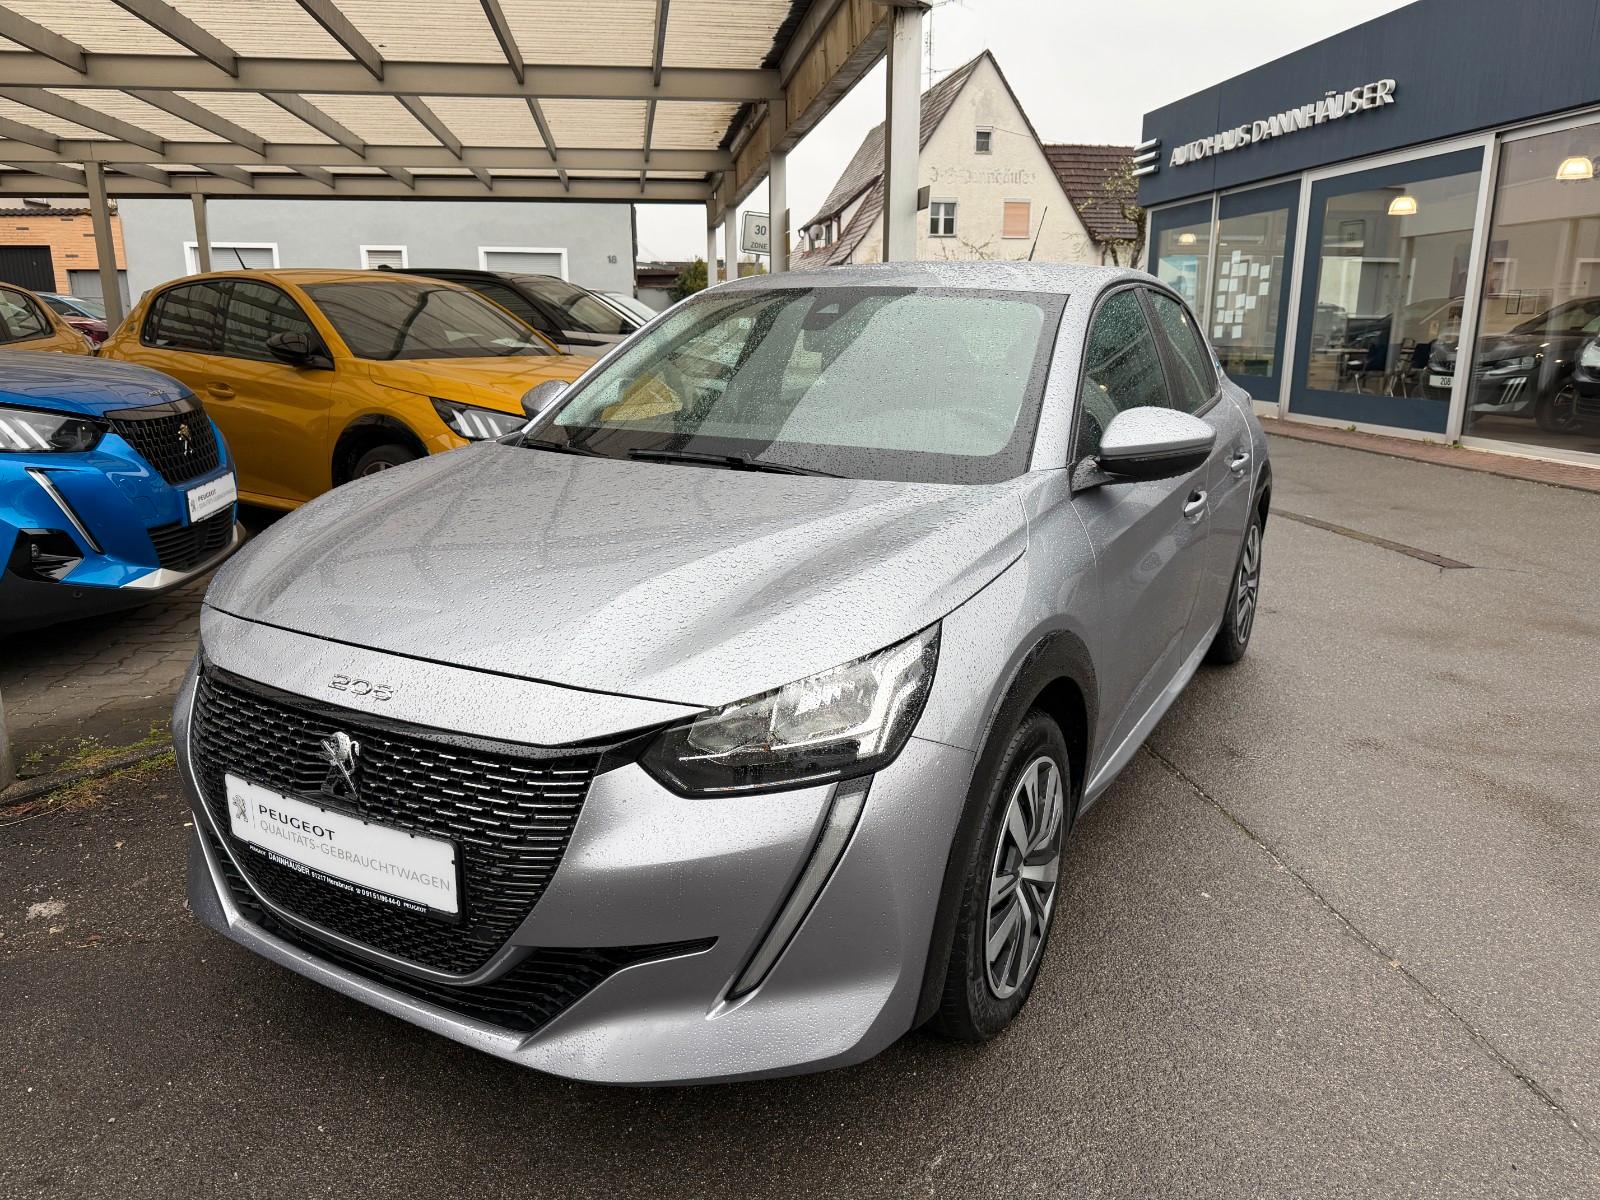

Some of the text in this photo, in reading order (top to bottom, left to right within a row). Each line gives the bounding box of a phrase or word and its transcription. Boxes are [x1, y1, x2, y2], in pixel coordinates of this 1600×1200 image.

[1169, 78, 1396, 167] AUTOHAUS DANNHÄUSER
[754, 225, 767, 236] 30
[750, 242, 768, 250] ZONE
[258, 804, 335, 841] PEUGEOT
